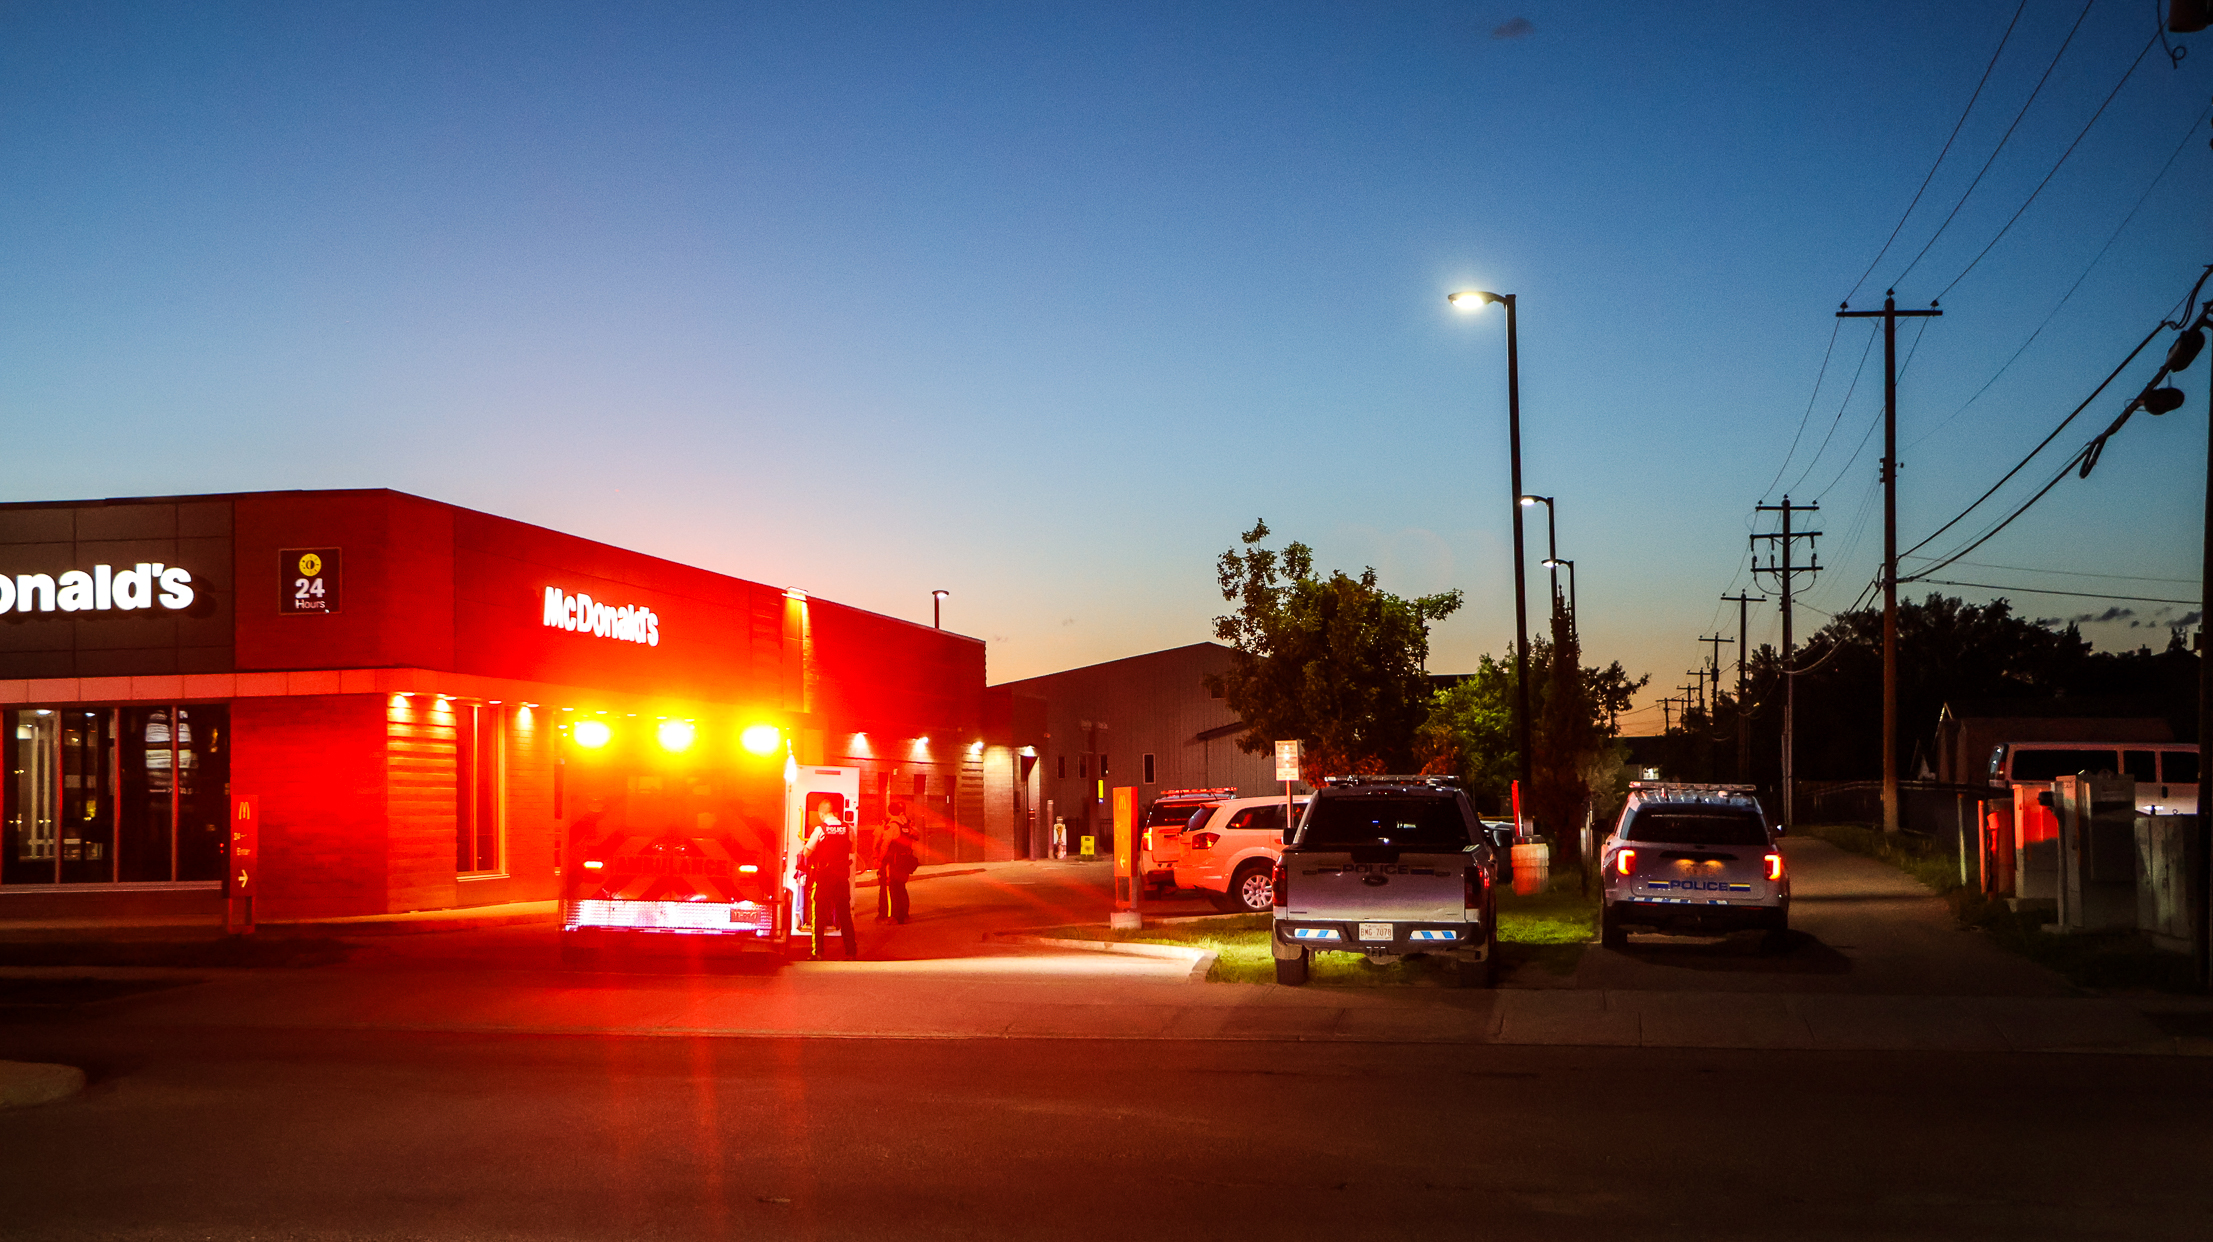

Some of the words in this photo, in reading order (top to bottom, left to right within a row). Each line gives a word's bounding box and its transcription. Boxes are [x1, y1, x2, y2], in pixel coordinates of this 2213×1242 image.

[295, 578, 326, 599] 24
[295, 599, 326, 609] Hours
[543, 586, 659, 647] McDonald's
[1342, 863, 1409, 875] POLICE
[1670, 880, 1728, 892] POLICE
